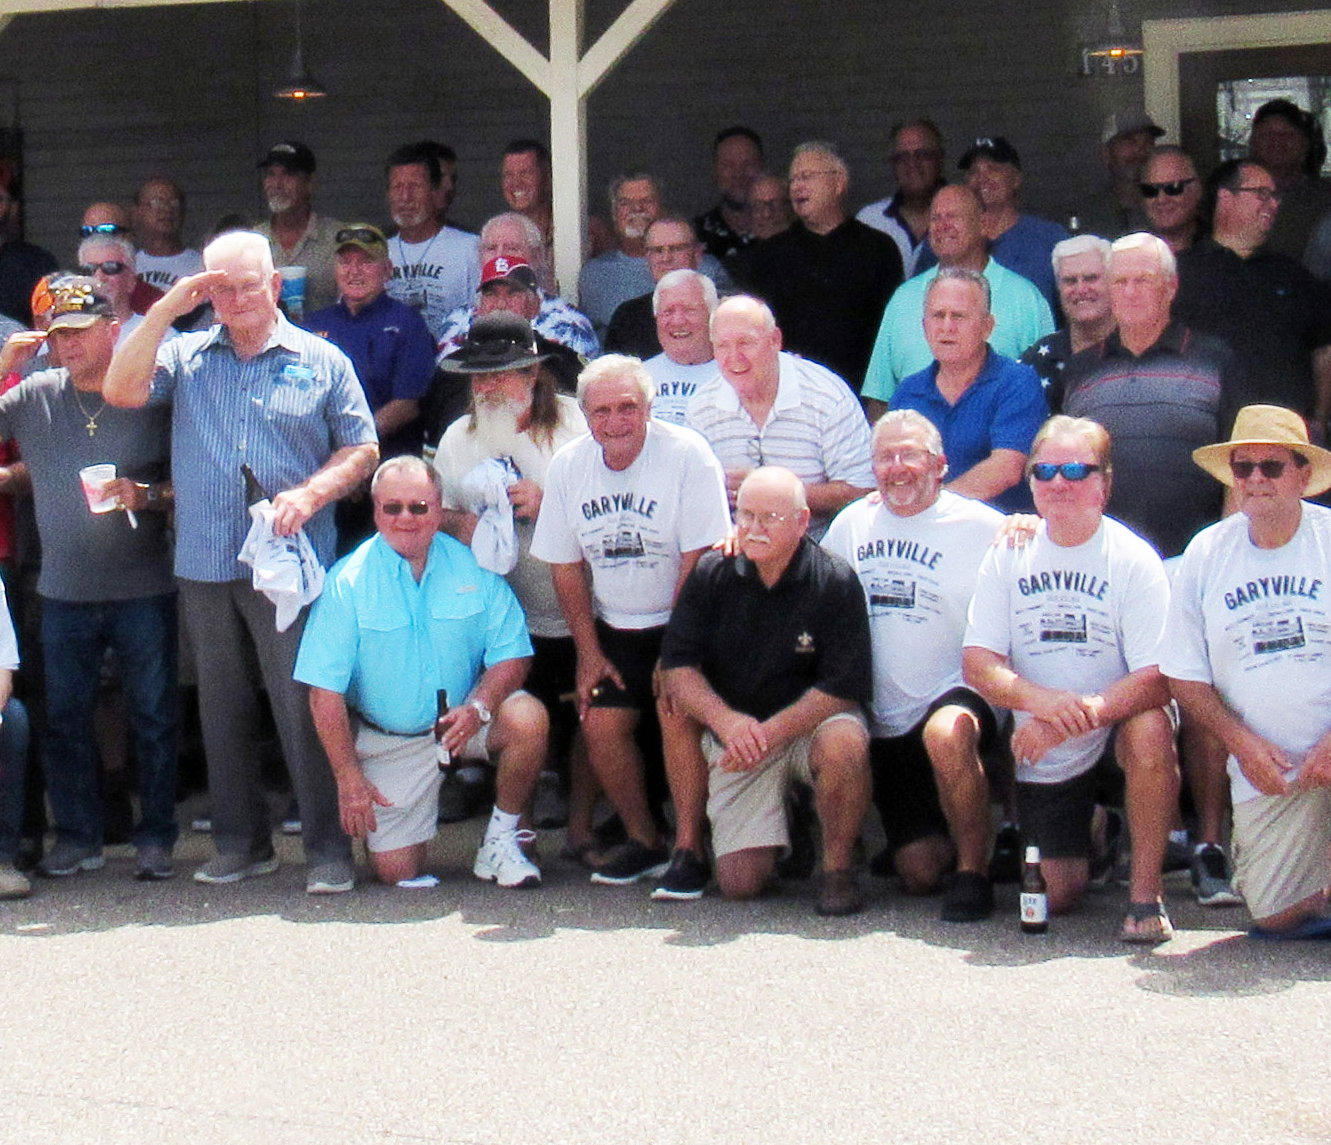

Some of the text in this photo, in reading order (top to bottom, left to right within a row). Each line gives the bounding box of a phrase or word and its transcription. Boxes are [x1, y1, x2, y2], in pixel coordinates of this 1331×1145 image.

[392, 262, 444, 280] RYVILLE
[857, 539, 943, 571] GARYVILLE
[1018, 570, 1109, 601] GARYVILLE
[1224, 574, 1323, 610] GARYVILLE
